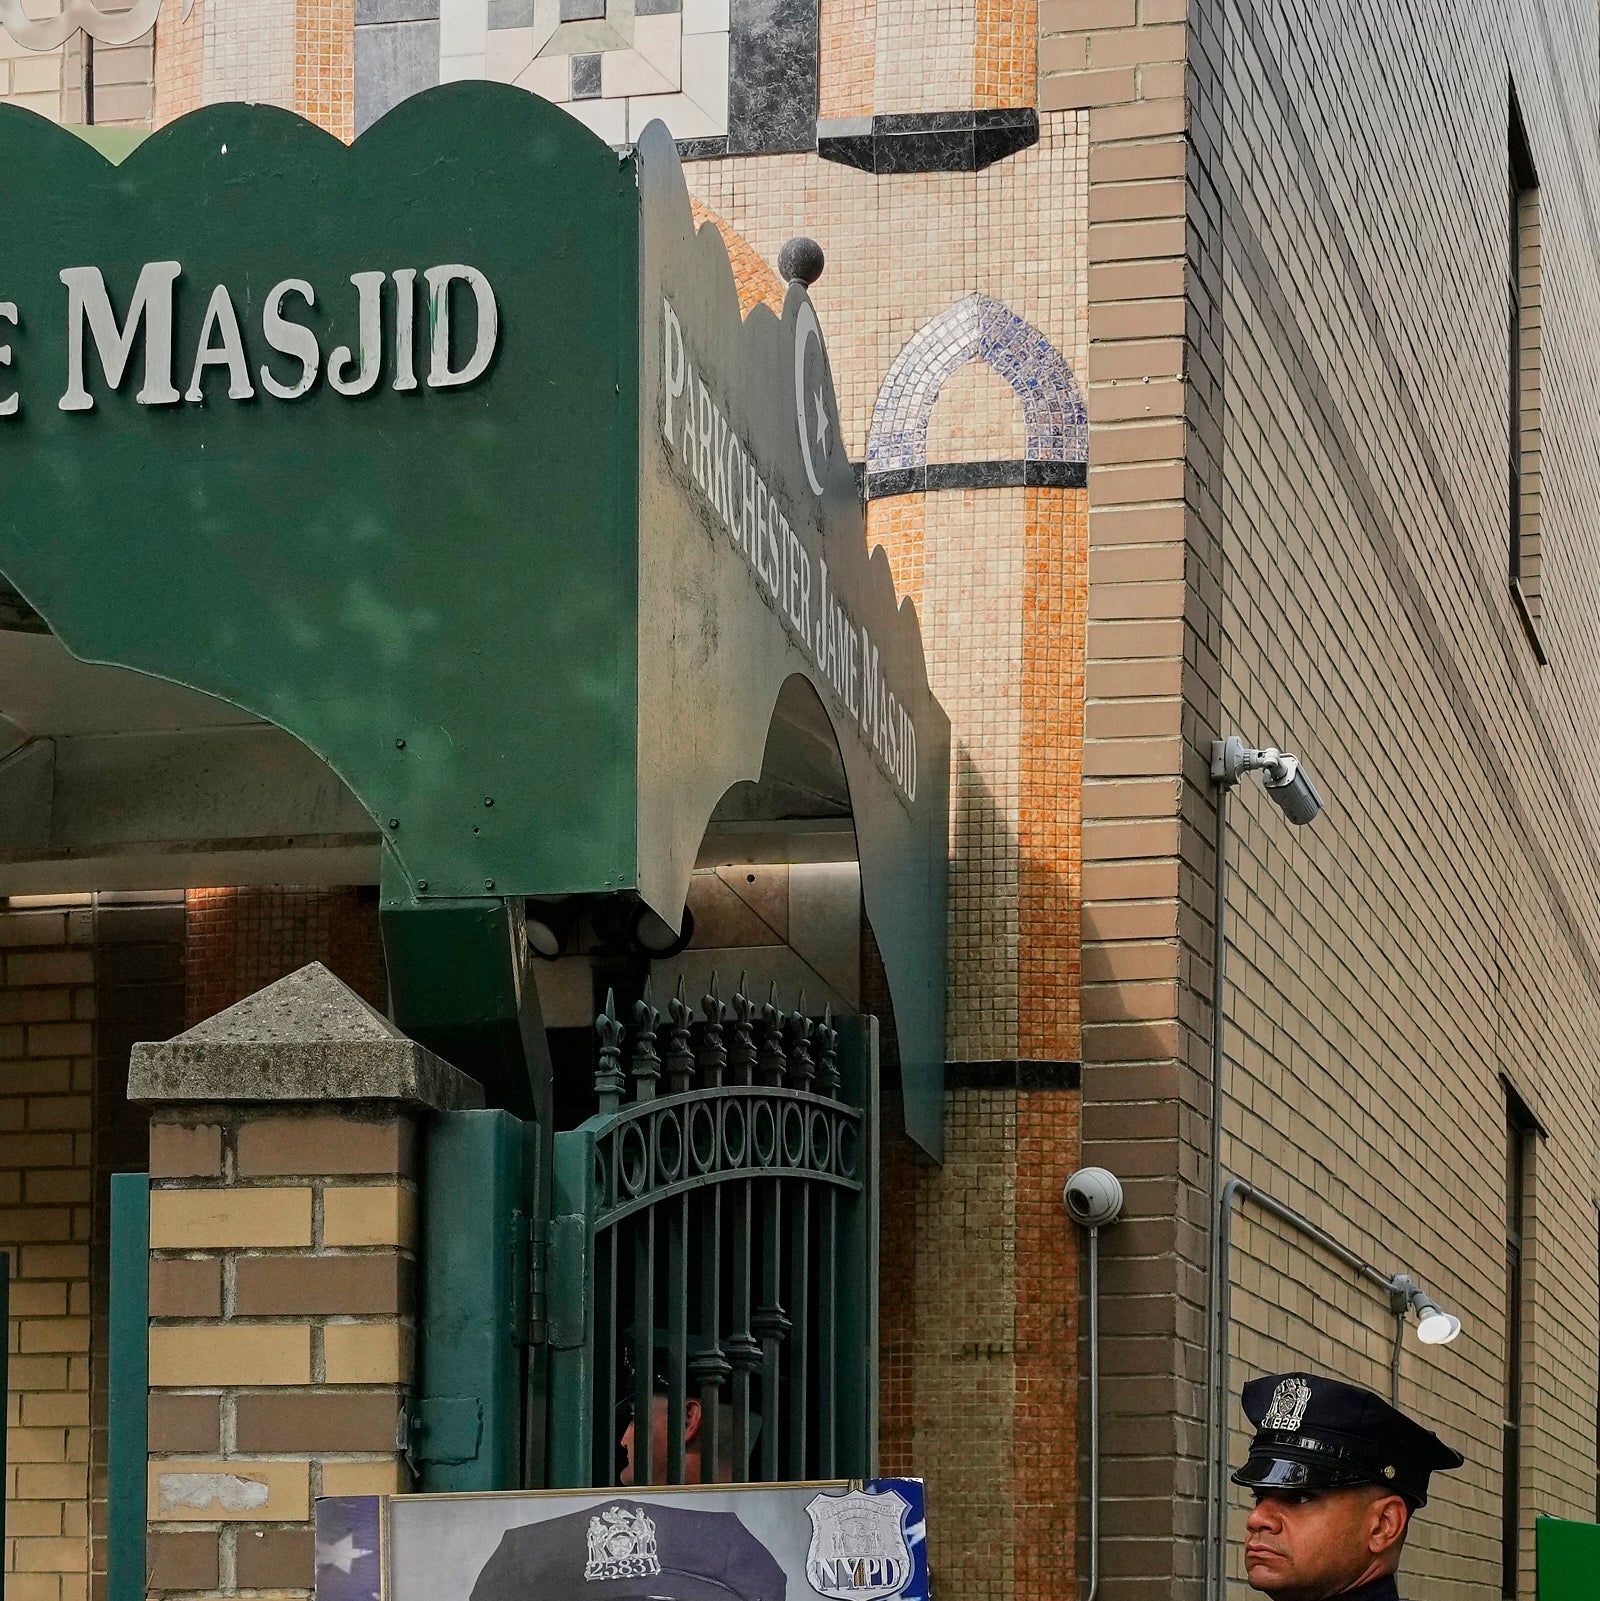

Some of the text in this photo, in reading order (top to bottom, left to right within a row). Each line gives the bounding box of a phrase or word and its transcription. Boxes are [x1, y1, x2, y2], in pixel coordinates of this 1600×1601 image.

[58, 260, 498, 410] MASJID
[663, 296, 917, 802] PARKCHESTER JAME MASJID
[589, 1557, 658, 1578] 25831
[816, 1556, 902, 1592] NYPD
